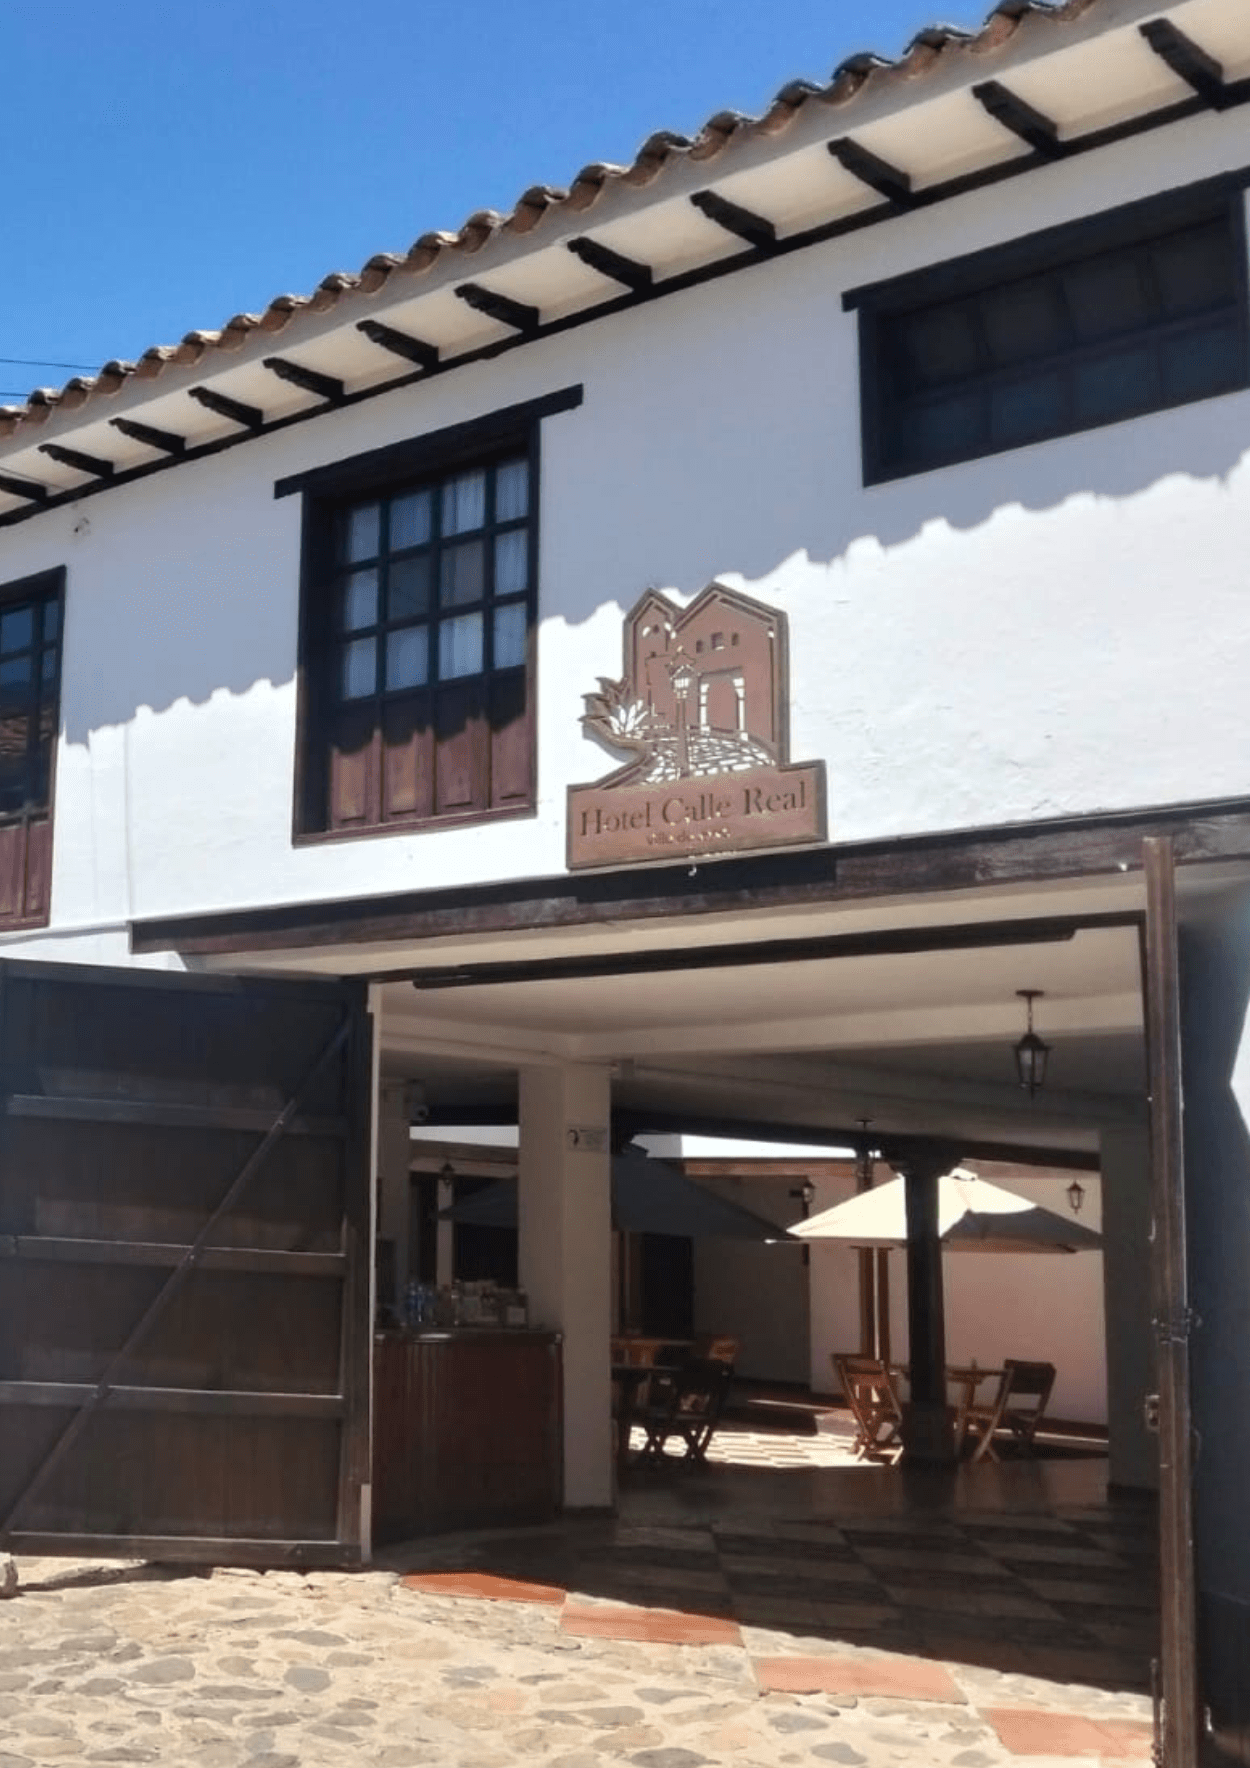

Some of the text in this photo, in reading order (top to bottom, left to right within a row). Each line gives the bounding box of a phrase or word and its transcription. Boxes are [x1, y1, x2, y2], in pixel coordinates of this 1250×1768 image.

[580, 780, 806, 836] Hotel Calle Real
